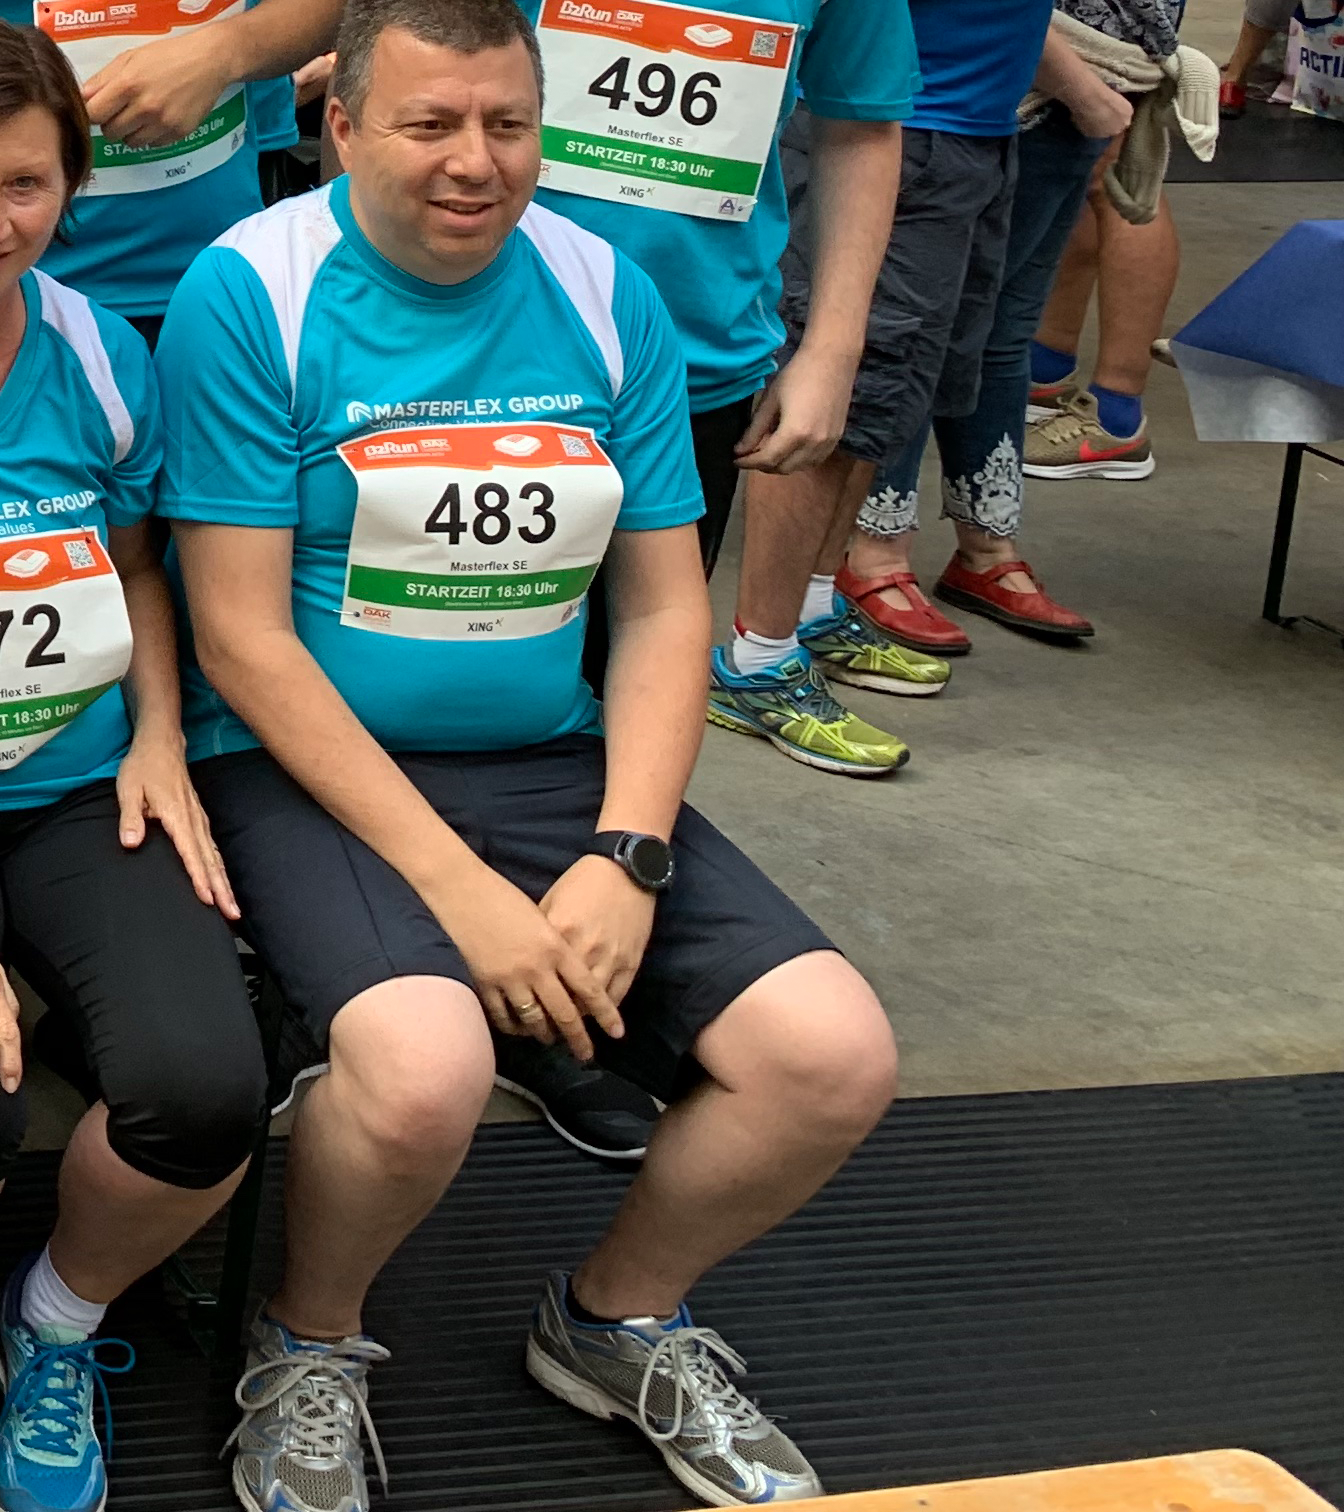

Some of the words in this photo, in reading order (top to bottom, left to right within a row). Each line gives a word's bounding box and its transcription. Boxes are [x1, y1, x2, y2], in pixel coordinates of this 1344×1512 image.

[588, 56, 722, 126] 496
[607, 125, 665, 145] Masterflex
[668, 136, 684, 147] SE
[566, 140, 647, 166] STARTZEIT
[649, 156, 687, 174] 18:30
[689, 163, 714, 178] Uhr
[164, 165, 186, 179] XING
[619, 185, 645, 199] XING
[374, 398, 502, 420] MASTERFLEX
[509, 393, 584, 414] GROUP
[36, 490, 96, 515] GROUP
[424, 482, 557, 545] 483
[450, 561, 509, 571] Masterflex
[512, 560, 528, 570] SE
[406, 582, 492, 598] STARTZEIT
[496, 584, 532, 599] 18:30
[534, 581, 559, 595] Uhr
[467, 621, 494, 632] XING
[25, 684, 42, 695] SE
[13, 705, 51, 724] 18:30
[54, 701, 80, 717] Uhr
